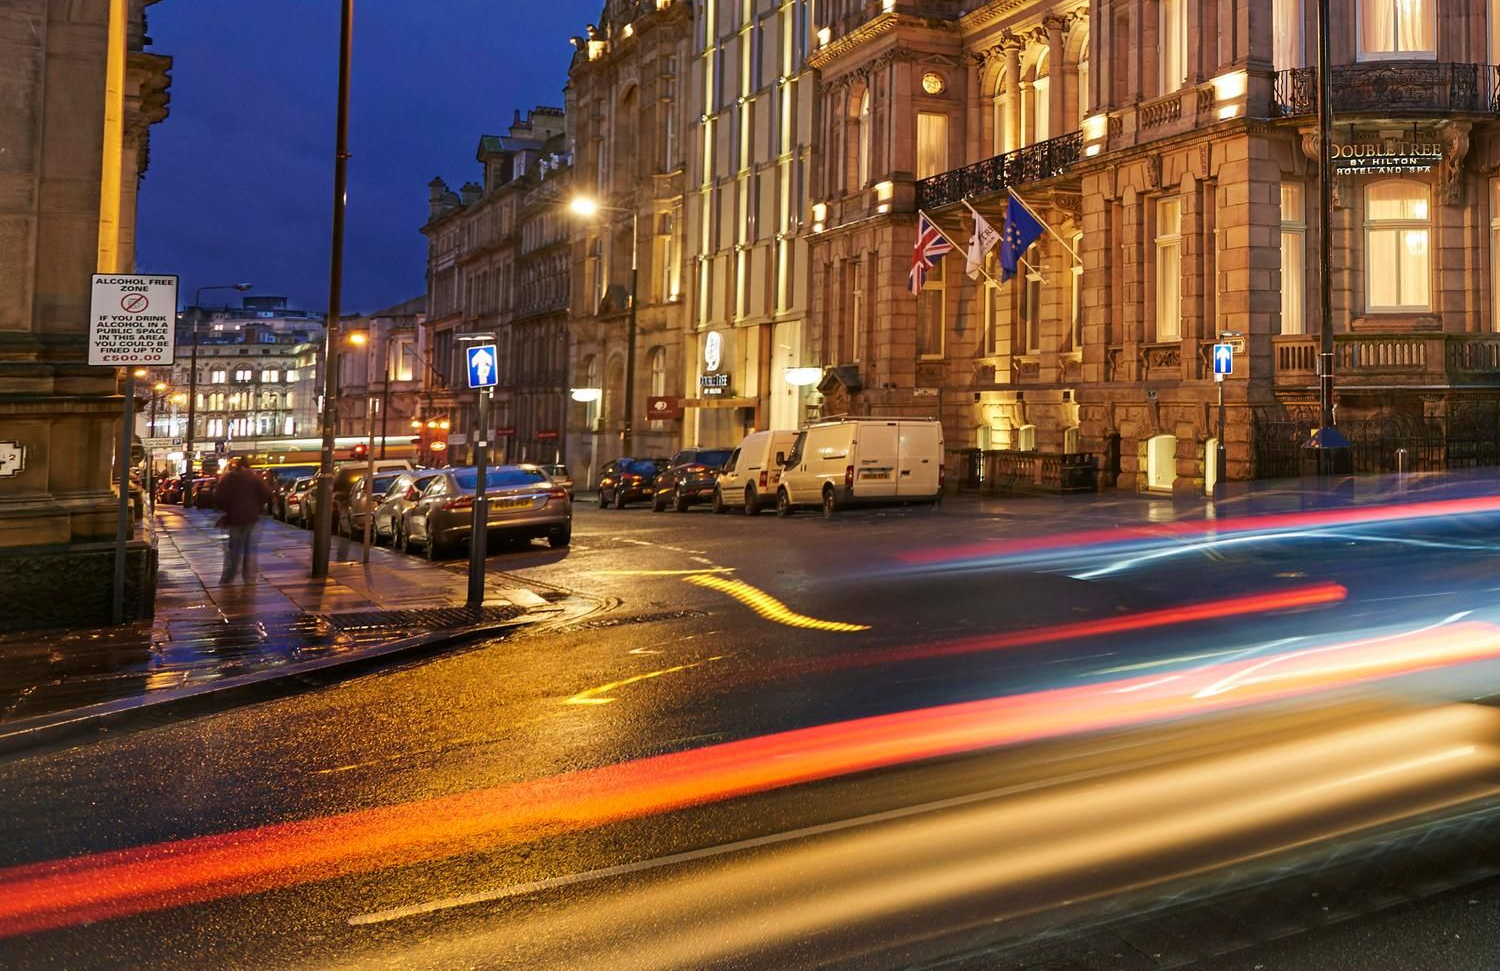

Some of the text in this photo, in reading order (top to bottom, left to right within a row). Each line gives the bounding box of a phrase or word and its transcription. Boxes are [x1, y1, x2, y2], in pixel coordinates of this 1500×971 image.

[1331, 142, 1442, 158] DOUBLETREE
[1336, 167, 1373, 175] HOTEL
[1379, 166, 1402, 174] AND
